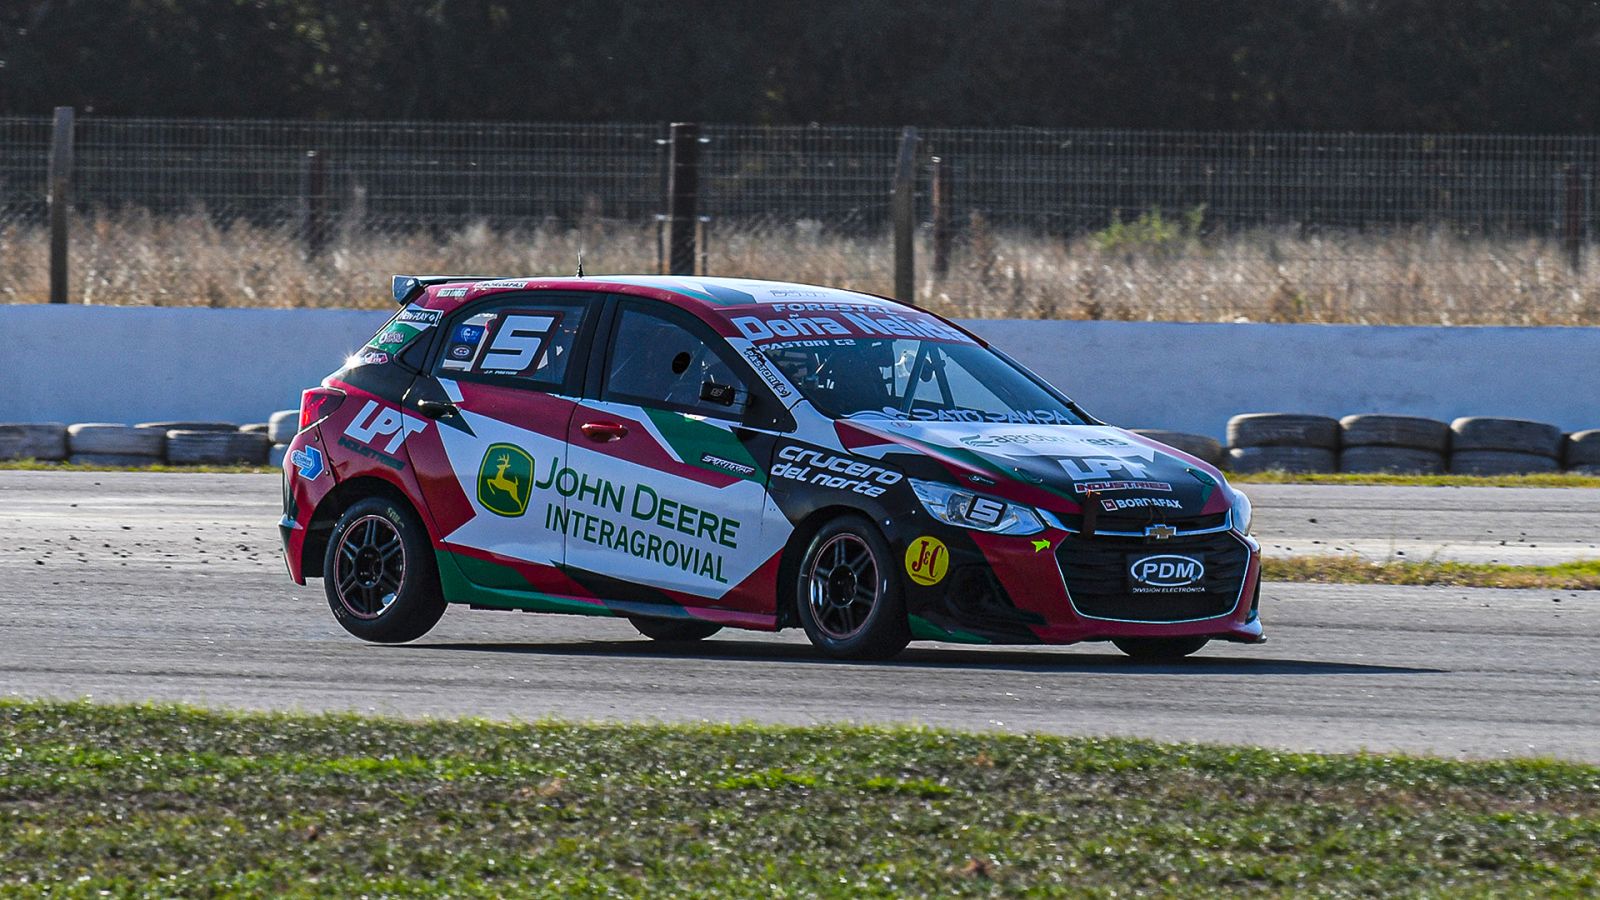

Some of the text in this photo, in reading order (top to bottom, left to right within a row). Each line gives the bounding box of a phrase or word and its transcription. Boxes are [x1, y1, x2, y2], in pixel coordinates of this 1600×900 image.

[772, 303, 900, 315] FORESTAL
[730, 313, 851, 341] Doña
[480, 315, 555, 370] 5
[757, 339, 830, 351] PASTORI
[344, 400, 428, 455] LPT
[770, 463, 886, 498] del norte
[1057, 459, 1148, 481] LPT
[970, 498, 1003, 523] 5
[1116, 499, 1183, 509] BORDAFAX
[545, 503, 728, 584] INTERAGROVIAL
[1143, 563, 1194, 578] PDM
